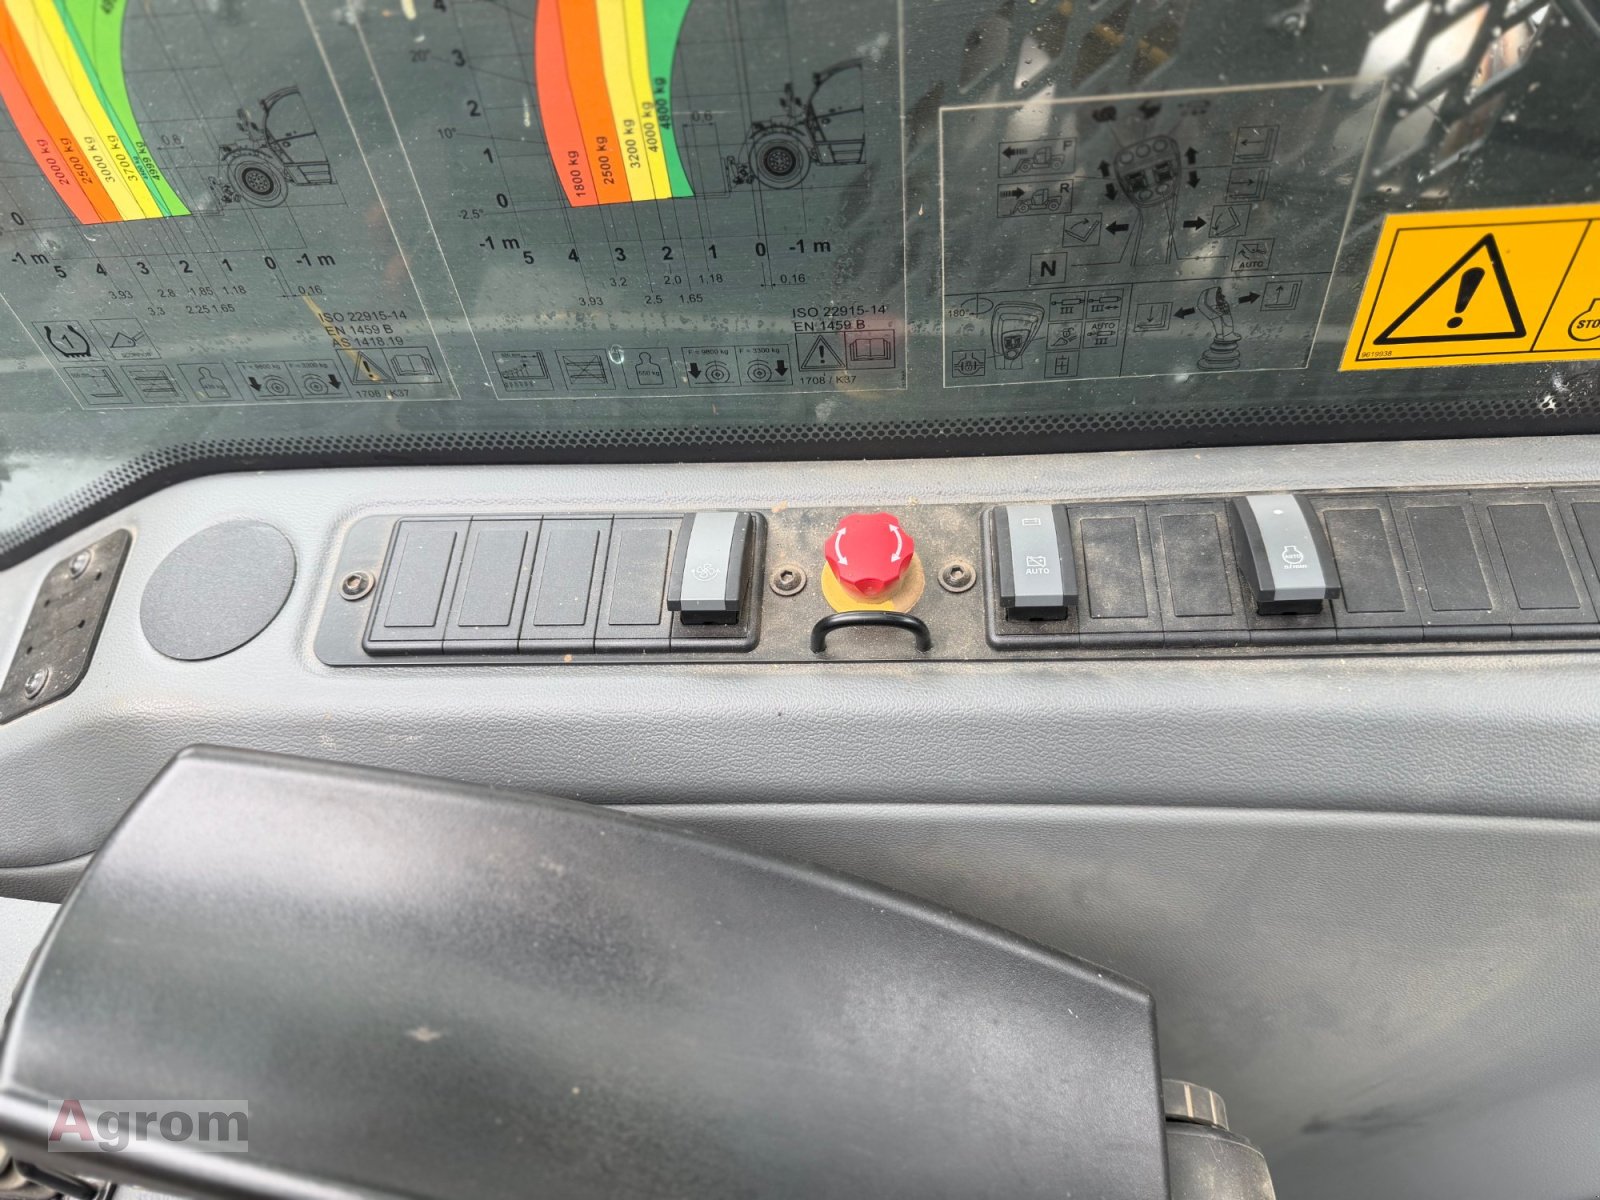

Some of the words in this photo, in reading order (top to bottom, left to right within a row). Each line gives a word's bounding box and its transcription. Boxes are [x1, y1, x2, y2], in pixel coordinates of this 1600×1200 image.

[452, 49, 466, 67] 3
[654, 78, 666, 94] kg
[467, 100, 481, 117] 2
[642, 102, 653, 118] kg
[657, 99, 671, 130] 4800
[623, 119, 635, 135] kg
[84, 137, 96, 152] kg
[107, 135, 120, 150] kg
[596, 136, 608, 151] kg
[644, 122, 658, 153] 4000
[37, 139, 48, 154] kg
[60, 138, 73, 153] kg
[1063, 140, 1072, 151] F
[483, 147, 494, 164] 1
[568, 151, 579, 166] kg
[626, 139, 640, 169] 3200
[47, 157, 70, 185] 2000
[69, 157, 93, 184] 2500
[93, 155, 115, 183] 3000
[116, 154, 138, 182] 3700
[598, 157, 614, 185] 2500
[570, 170, 586, 197] 1800
[1060, 183, 1070, 193] R
[496, 193, 508, 208] 0
[11, 212, 24, 225] 0
[479, 236, 495, 250] -1
[502, 238, 520, 249] m
[11, 252, 27, 265] -1
[31, 254, 49, 264] m
[523, 251, 534, 265] 5
[568, 249, 579, 263] 4
[614, 247, 626, 261] 3
[662, 246, 673, 260] 2
[709, 244, 717, 259] 1
[755, 242, 766, 257] 0
[789, 239, 805, 253] -1
[813, 240, 831, 252] m
[54, 265, 67, 279] 5
[96, 263, 107, 276] 4
[137, 261, 149, 275] 3
[179, 260, 193, 273] 2
[222, 258, 233, 272] 1
[264, 256, 277, 270] 0
[296, 253, 312, 267] -1
[317, 254, 336, 266] m
[1040, 260, 1057, 277] N
[1239, 261, 1264, 269] AUTO
[319, 312, 344, 323] ISO
[347, 310, 407, 322] 22915-14
[792, 307, 818, 318] ISO
[823, 304, 887, 317] 22915-14
[325, 325, 346, 336] EN
[349, 324, 380, 335] 1459
[383, 323, 394, 334] B
[794, 321, 815, 332] EN
[820, 320, 852, 331] 1459
[856, 319, 866, 329] B
[1091, 323, 1116, 331] AUTO
[332, 337, 351, 348] AS
[355, 336, 404, 347] 1418.19
[800, 376, 826, 385] 1708
[835, 374, 857, 384] K37
